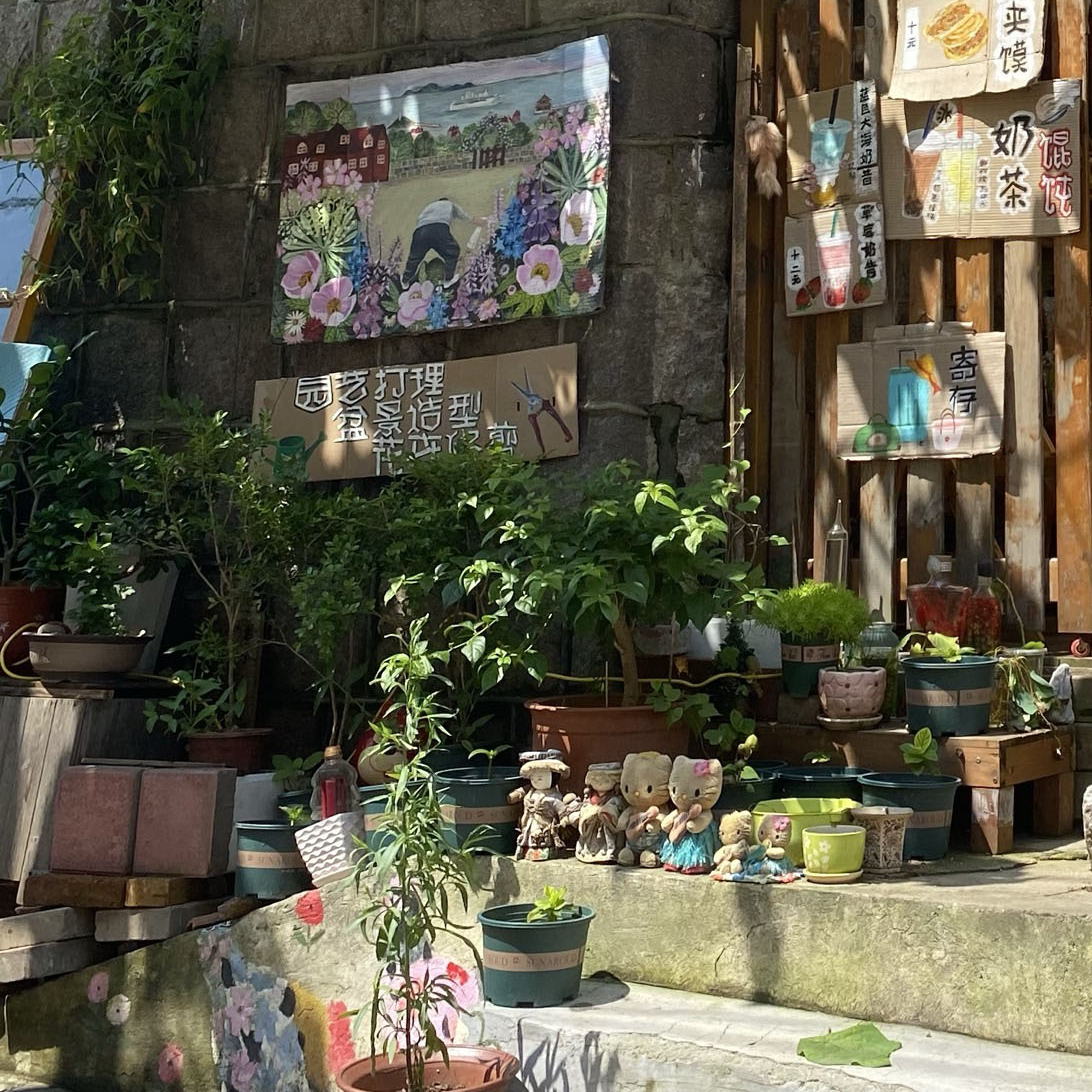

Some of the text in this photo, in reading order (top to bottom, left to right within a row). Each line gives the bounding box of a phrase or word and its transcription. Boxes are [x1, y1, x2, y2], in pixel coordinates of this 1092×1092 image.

[907, 21, 917, 49] 十元
[992, 114, 1035, 208] 奶茶
[1038, 129, 1072, 217] 馄饨
[861, 204, 878, 279] 草莓奶昔
[294, 362, 445, 413] 园艺打理
[949, 345, 978, 415] 寄存
[331, 390, 482, 443] 盆景造型
